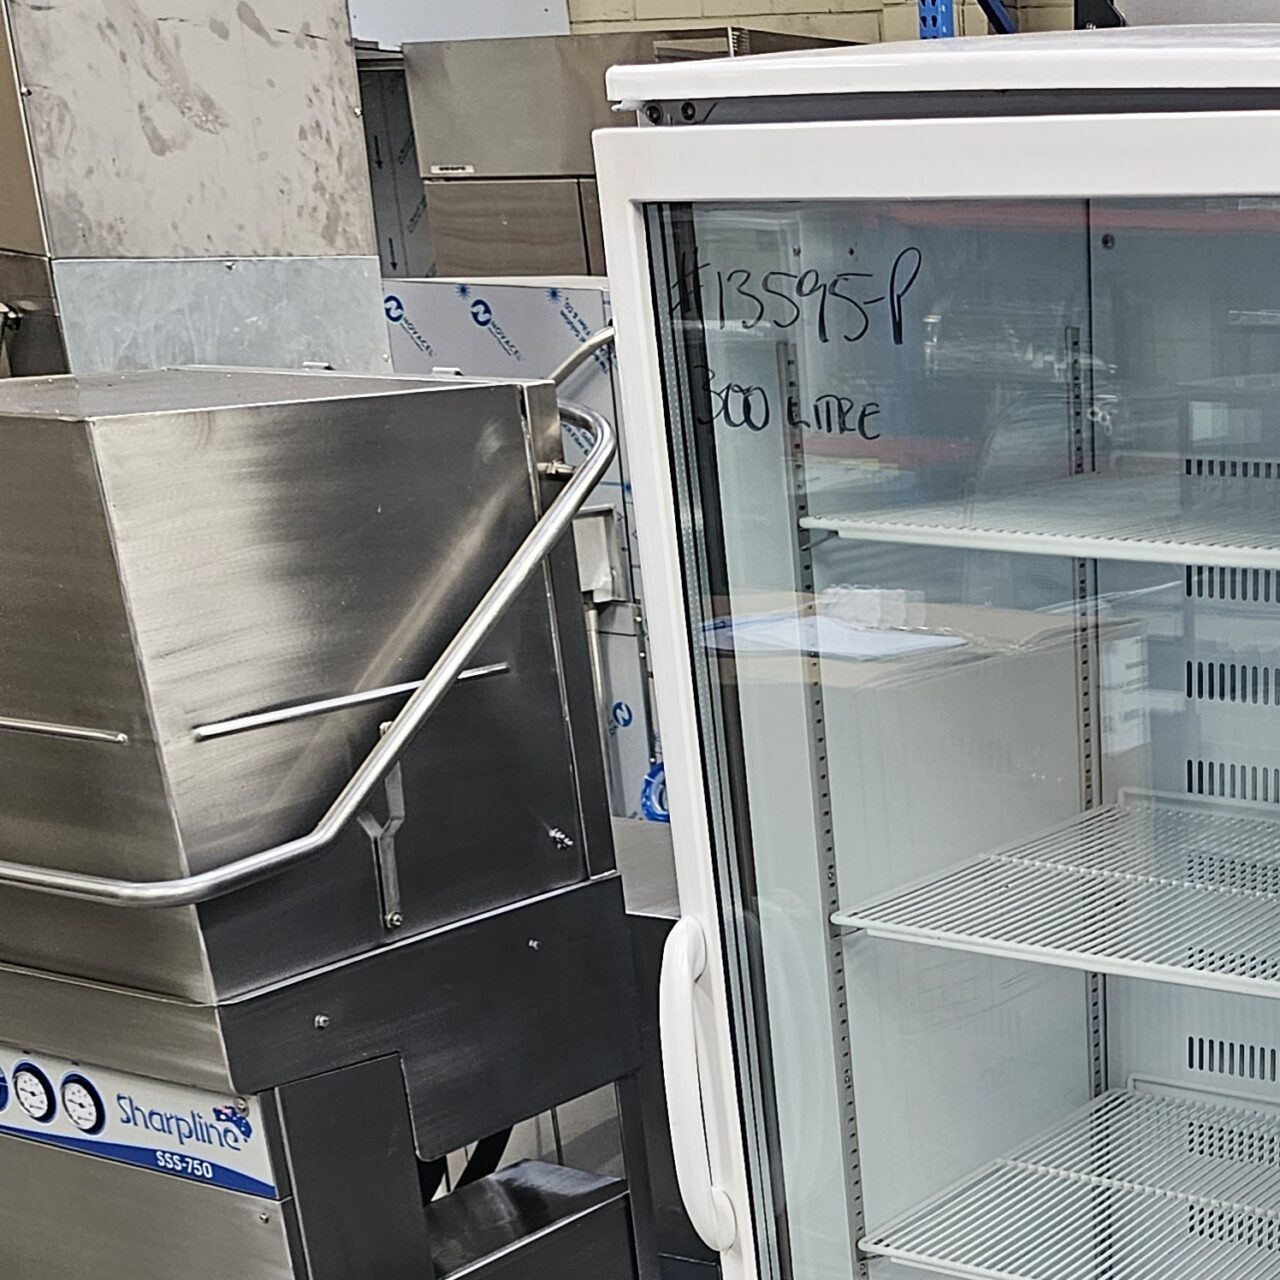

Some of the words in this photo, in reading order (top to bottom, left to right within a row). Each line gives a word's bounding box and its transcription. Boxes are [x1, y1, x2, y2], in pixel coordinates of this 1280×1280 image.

[694, 364, 770, 431] 300
[787, 394, 881, 440] LITRE
[117, 1093, 242, 1151] Sharpline
[155, 1150, 214, 1179] SSS-750
